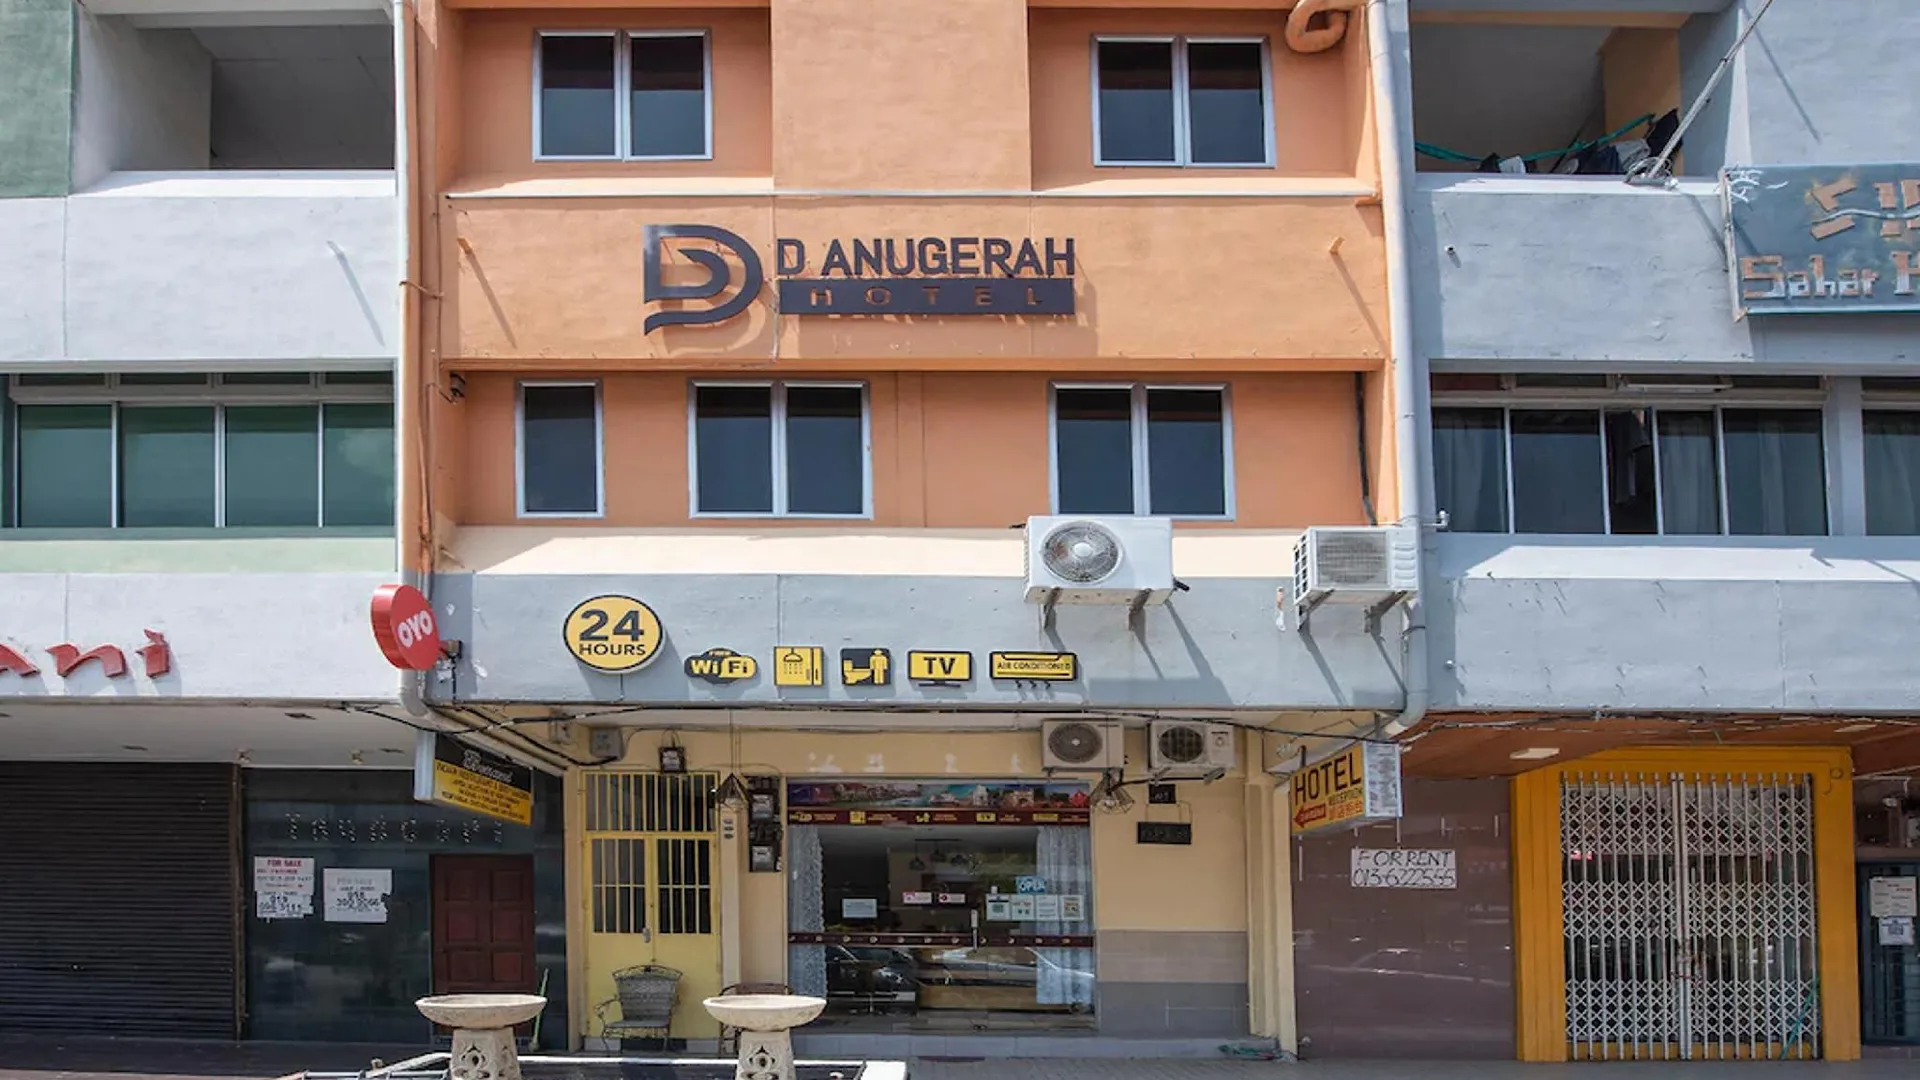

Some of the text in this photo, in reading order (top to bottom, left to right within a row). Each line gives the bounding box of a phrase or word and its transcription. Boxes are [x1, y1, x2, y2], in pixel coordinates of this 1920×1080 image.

[821, 237, 1075, 278] ANUGERAH
[1740, 254, 1880, 300] Sahar
[809, 285, 1043, 306] HOTEL
[397, 610, 433, 648] OYO
[579, 609, 645, 642] 24
[579, 643, 646, 656] HOURS
[923, 656, 956, 675] TV
[1294, 752, 1362, 806] HOTEL
